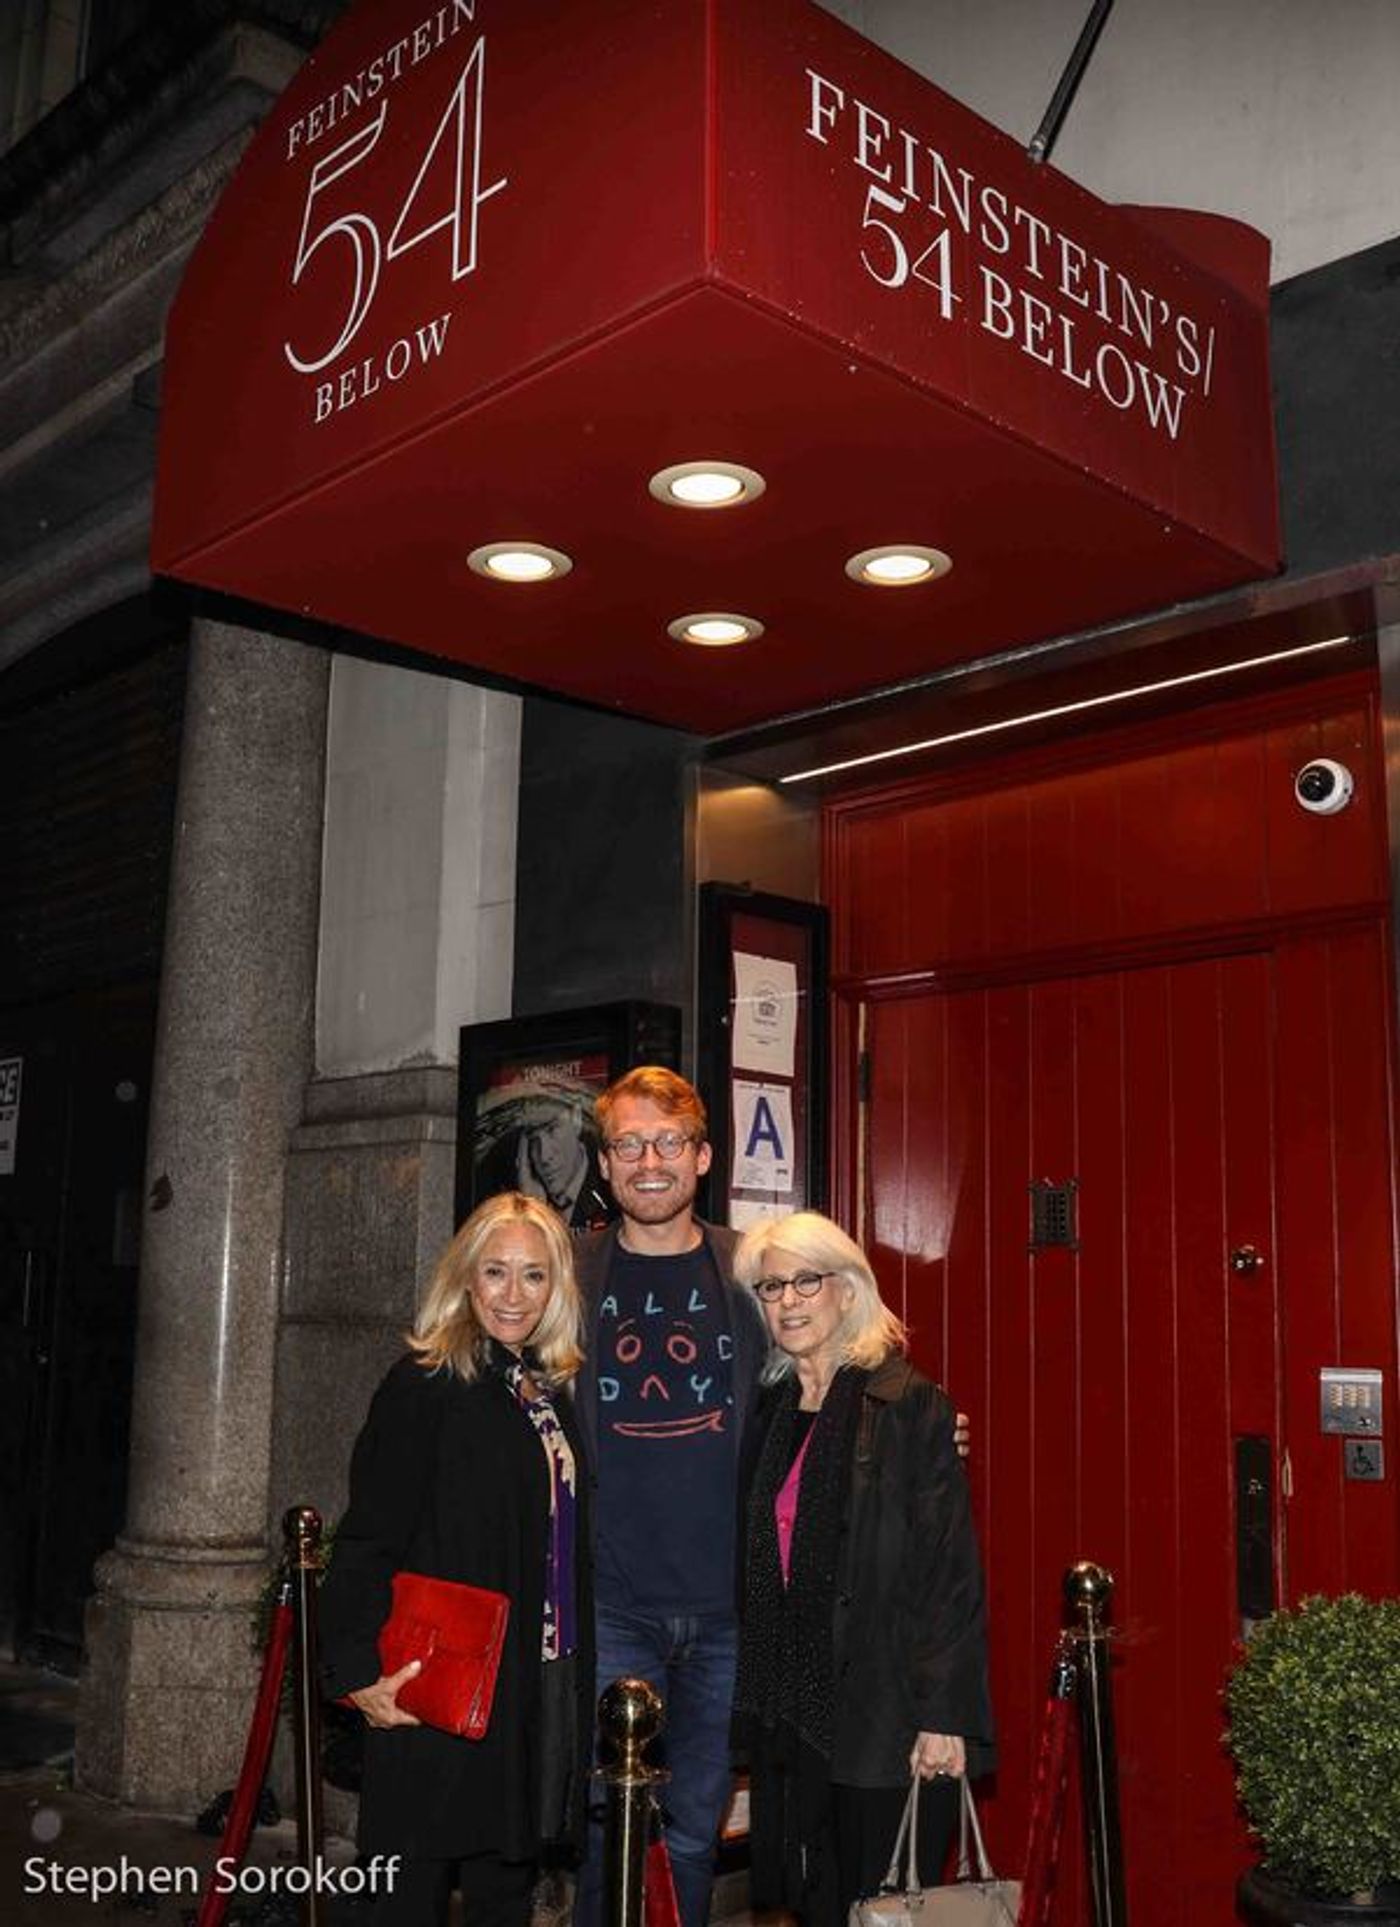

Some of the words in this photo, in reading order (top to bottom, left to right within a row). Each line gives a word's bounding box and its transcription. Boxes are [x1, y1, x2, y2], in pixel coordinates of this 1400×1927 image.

[284, 34, 507, 373] 54
[314, 312, 452, 423] BELOW
[860, 184, 963, 320] 54
[979, 264, 1187, 440] BELOW
[745, 1096, 783, 1160] A
[599, 1288, 707, 1317] ALL
